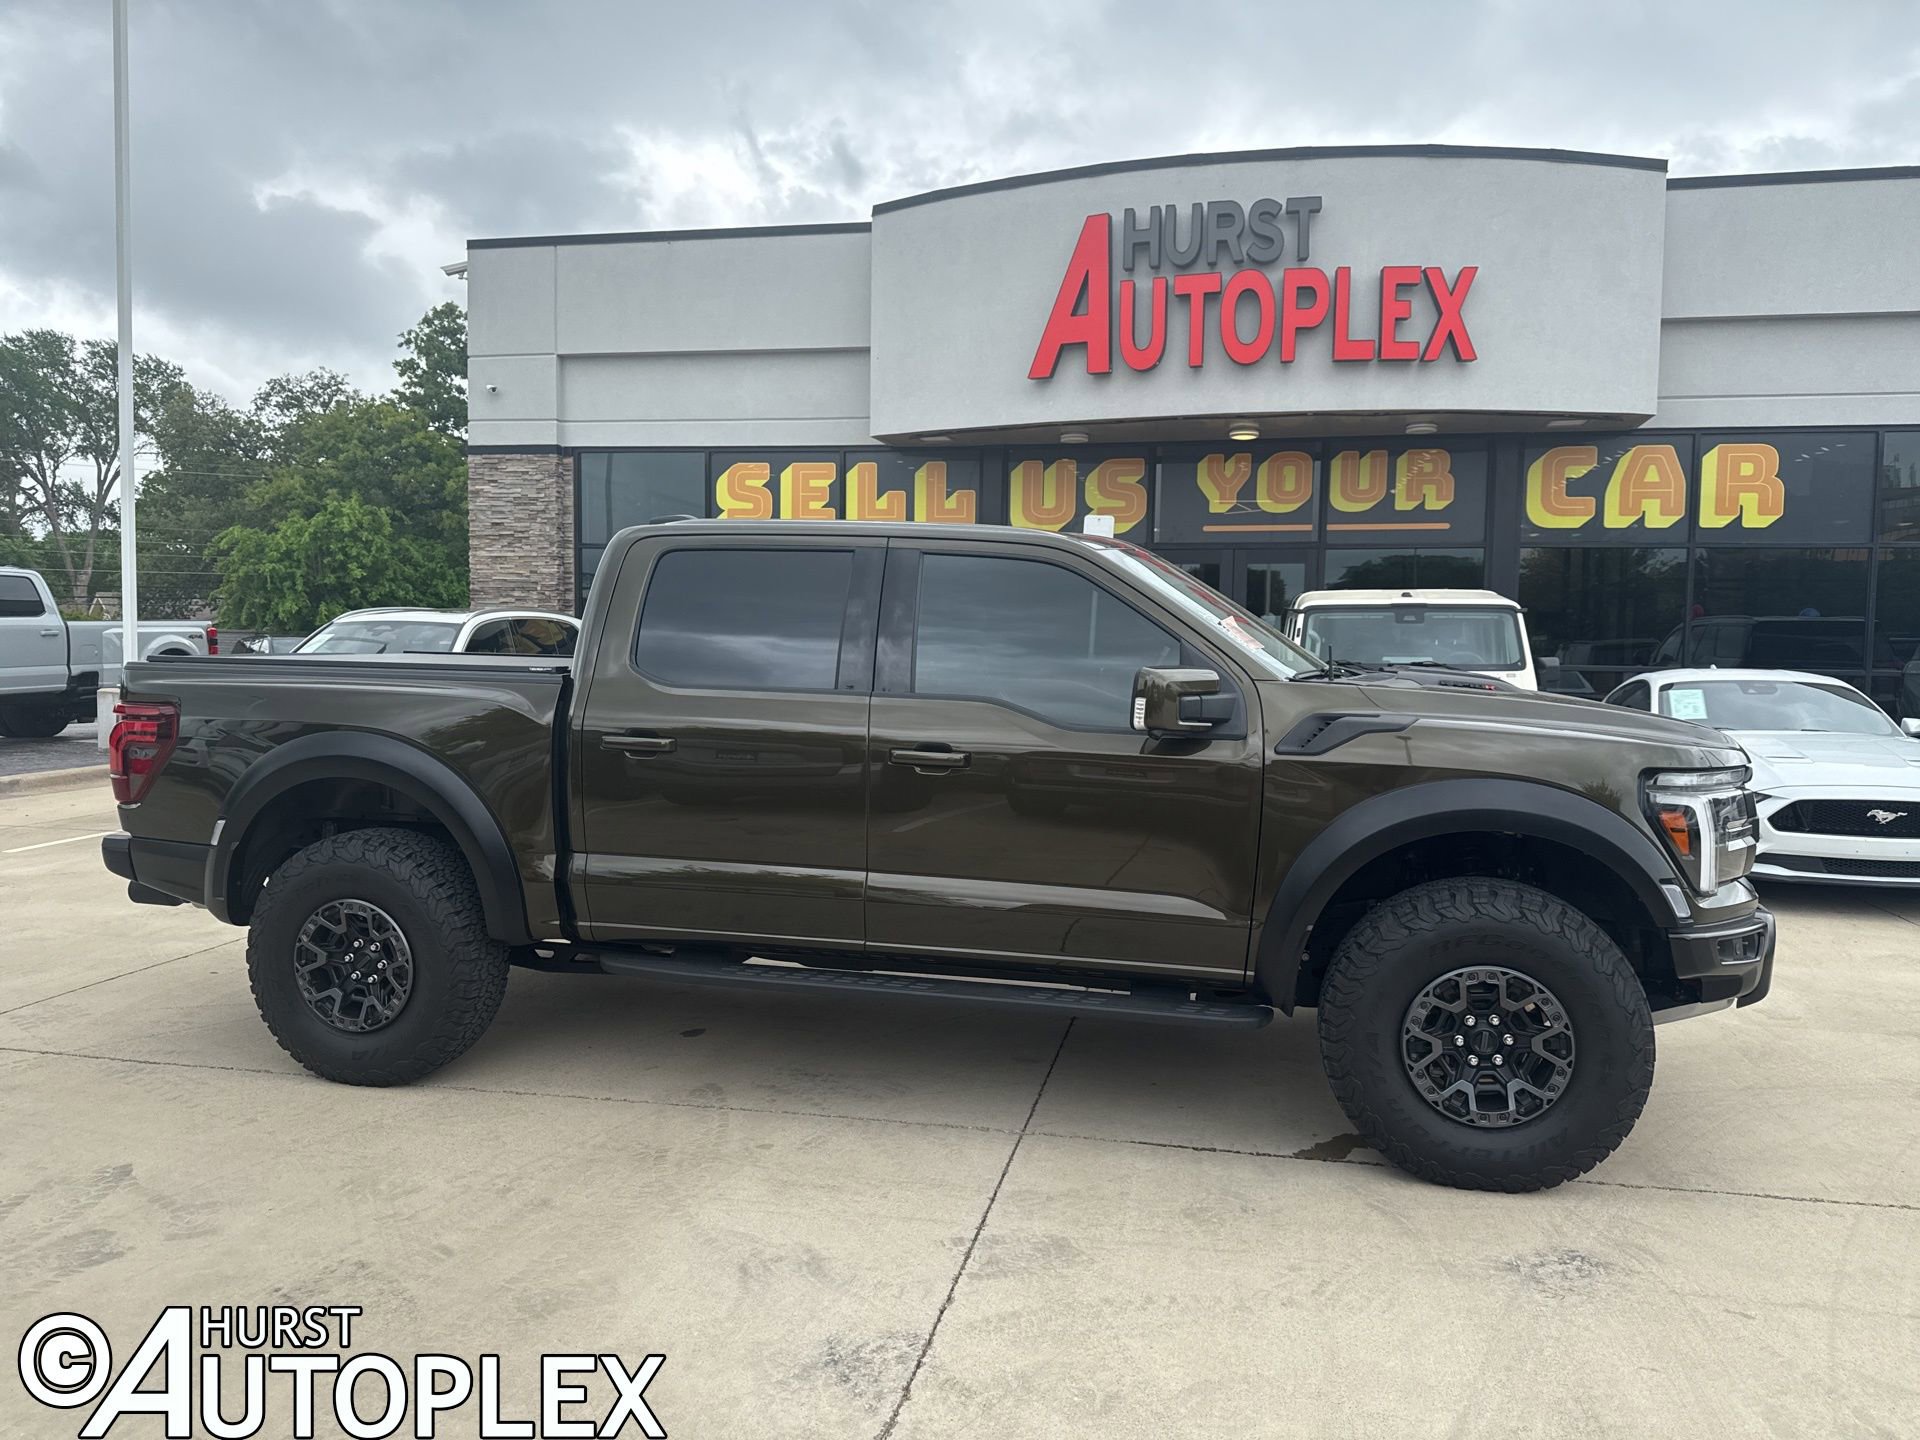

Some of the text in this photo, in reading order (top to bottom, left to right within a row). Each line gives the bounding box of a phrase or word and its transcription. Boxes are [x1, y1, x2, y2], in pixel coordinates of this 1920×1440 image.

[1122, 195, 1323, 271] HURST
[1027, 212, 1479, 380] AUTOPLEX
[715, 443, 1785, 533] SELL US YOUR CAR
